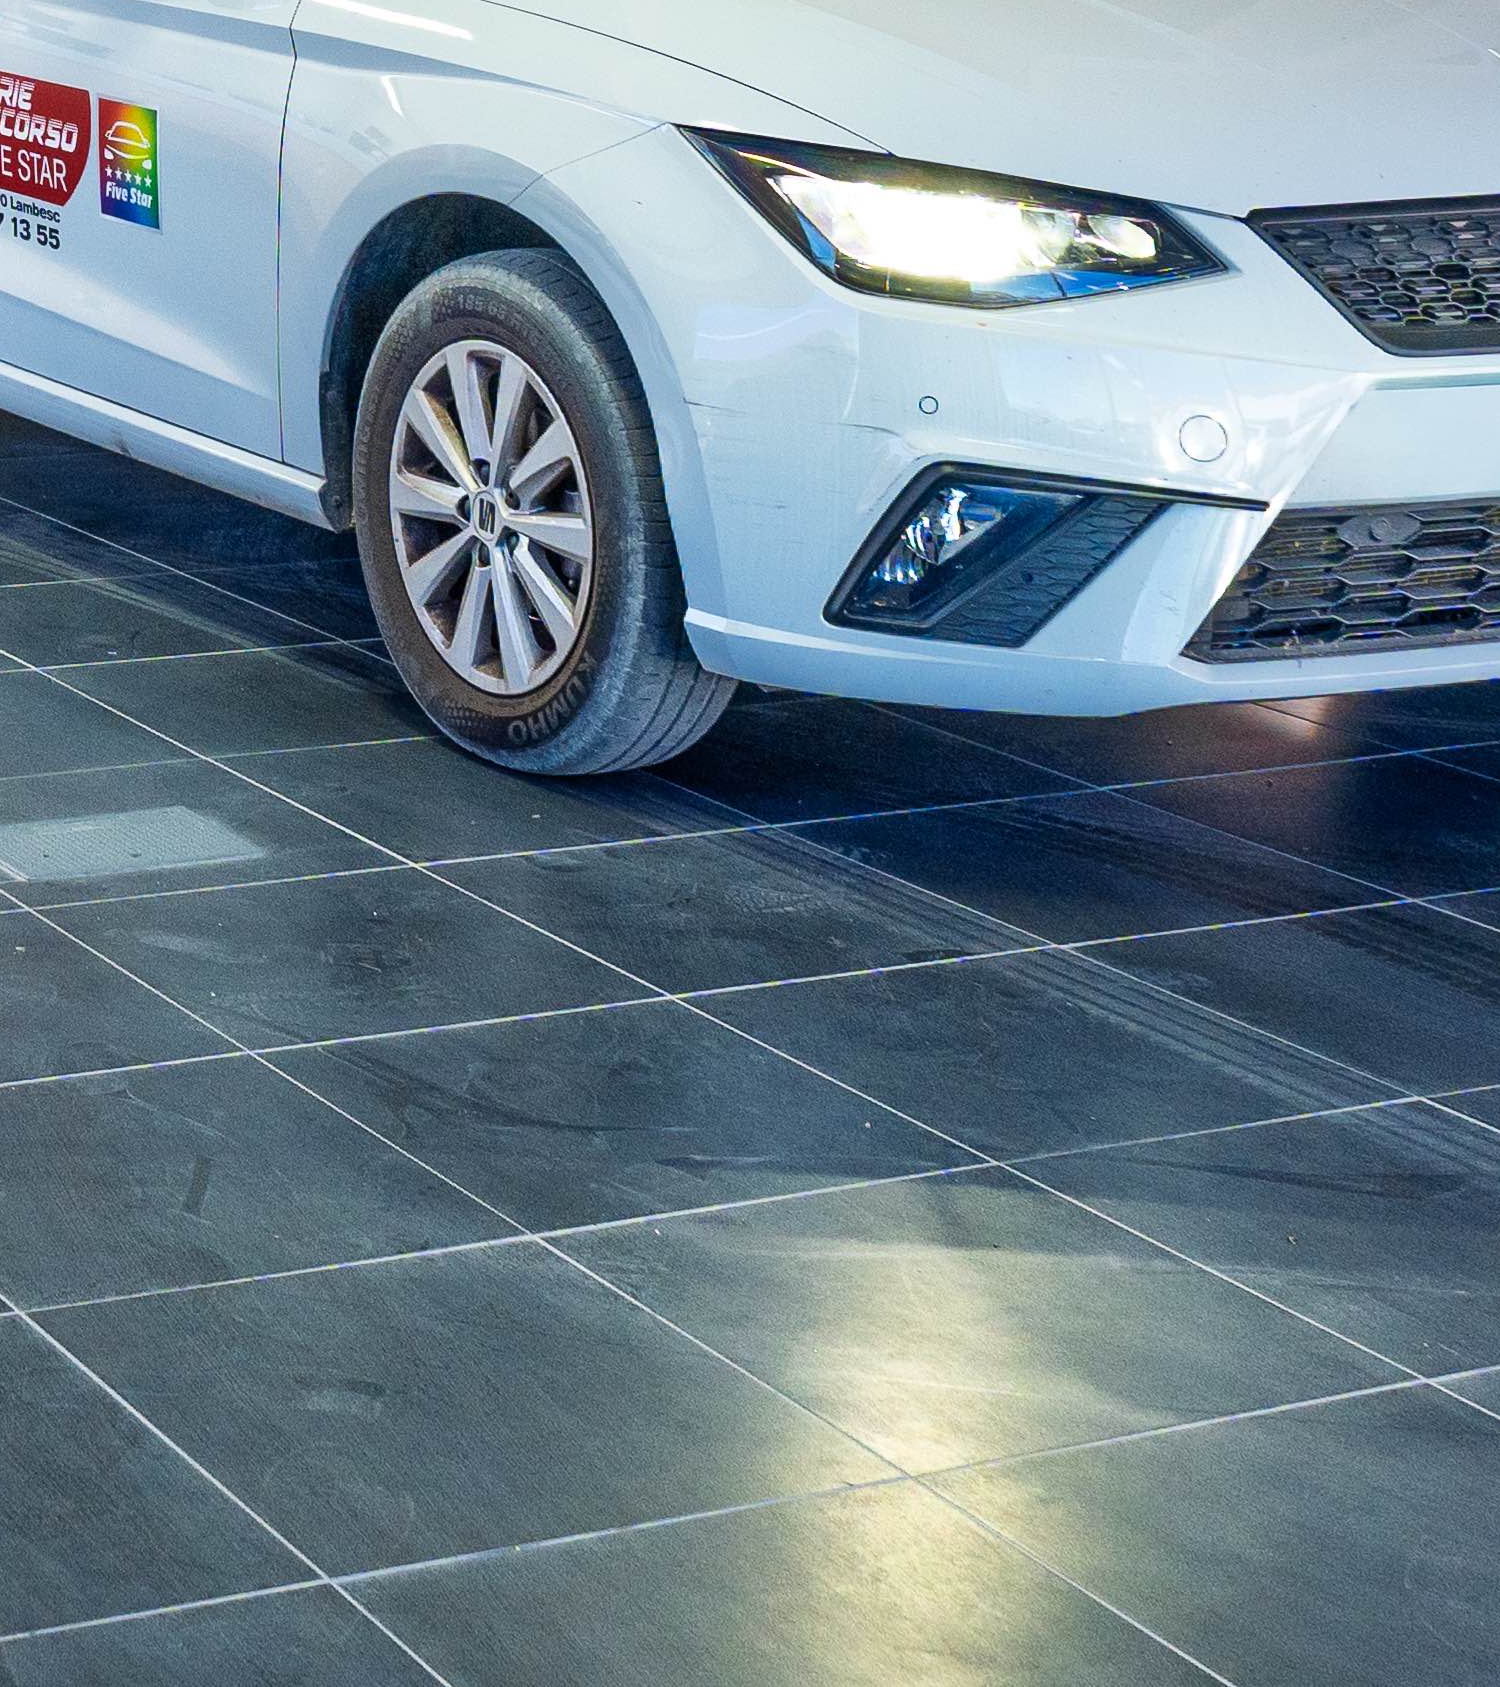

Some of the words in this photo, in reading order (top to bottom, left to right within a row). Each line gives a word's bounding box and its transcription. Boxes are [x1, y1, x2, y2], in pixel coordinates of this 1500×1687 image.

[17, 149, 68, 193] STAR
[10, 195, 61, 223] Lambesc
[105, 181, 129, 202] Five
[129, 187, 153, 209] Star
[11, 216, 31, 241] 13
[36, 224, 61, 250] 55
[508, 650, 597, 745] KUMHO
